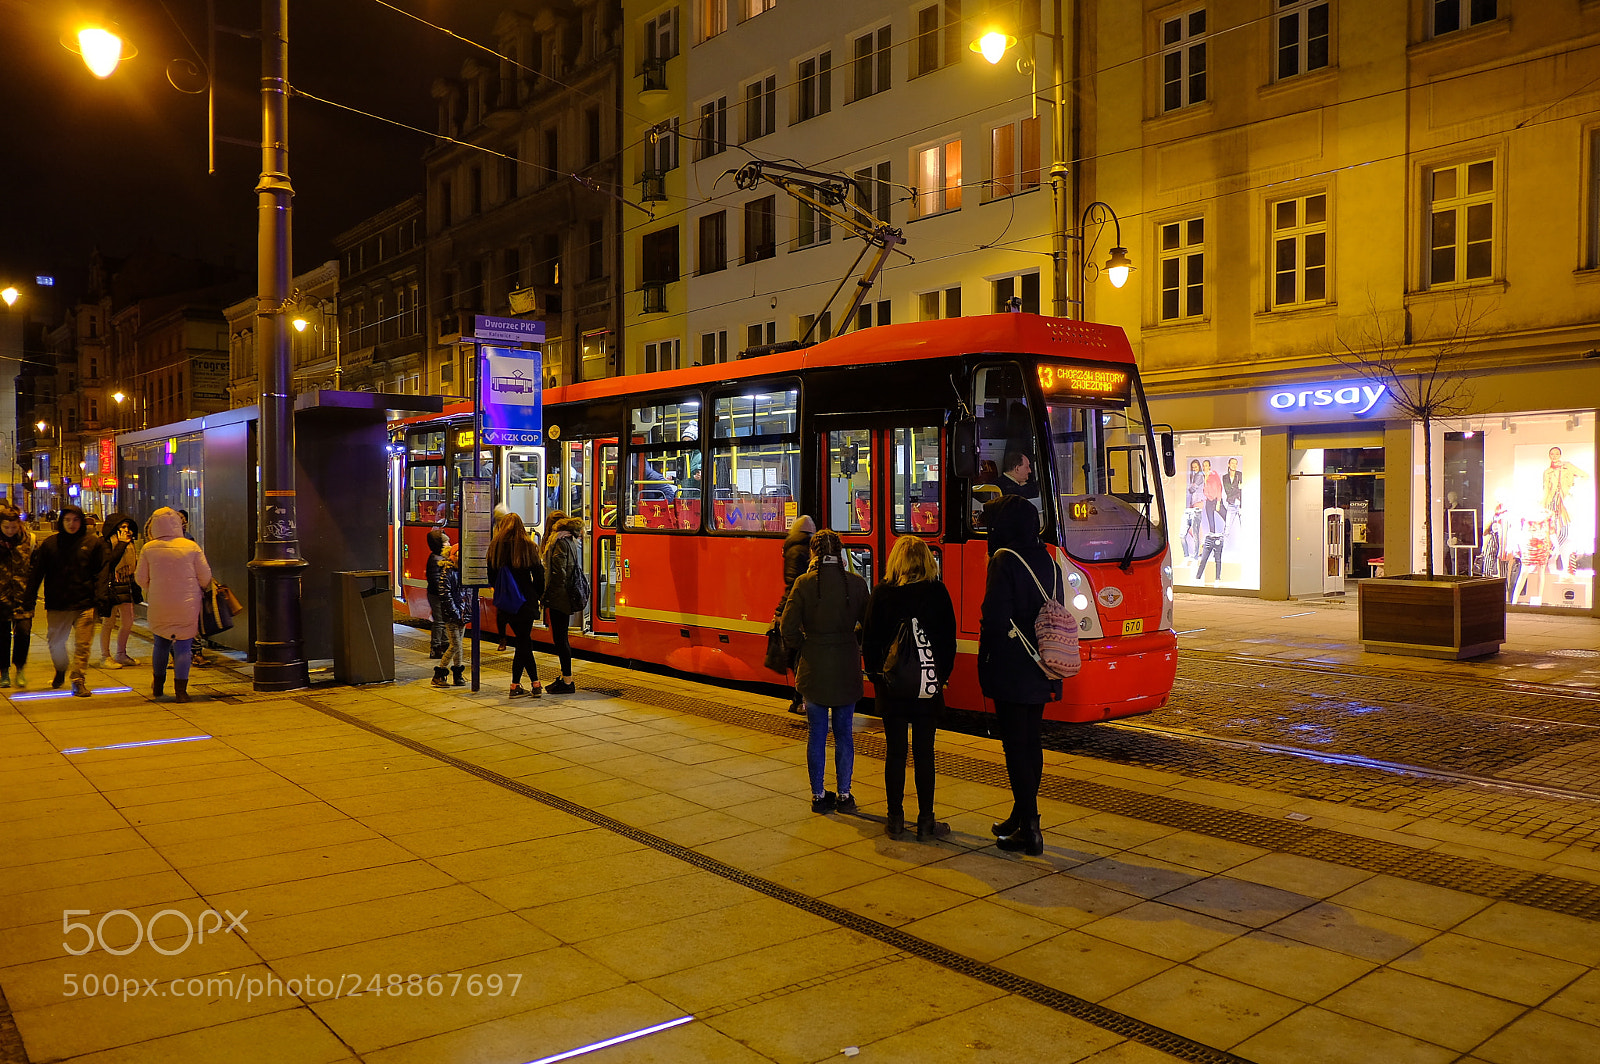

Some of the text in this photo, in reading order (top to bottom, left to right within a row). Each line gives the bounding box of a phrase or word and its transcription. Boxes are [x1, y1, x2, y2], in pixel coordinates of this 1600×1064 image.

[485, 319, 536, 332] Dworzec PKP
[1095, 371, 1125, 383] BATORY
[1071, 380, 1113, 392] ZAJEZDNIA
[1270, 383, 1386, 415] orsay
[501, 433, 539, 443] KZK GOP
[746, 512, 776, 521] KZK GOP
[1074, 503, 1087, 518] 04
[1125, 620, 1141, 632] 670
